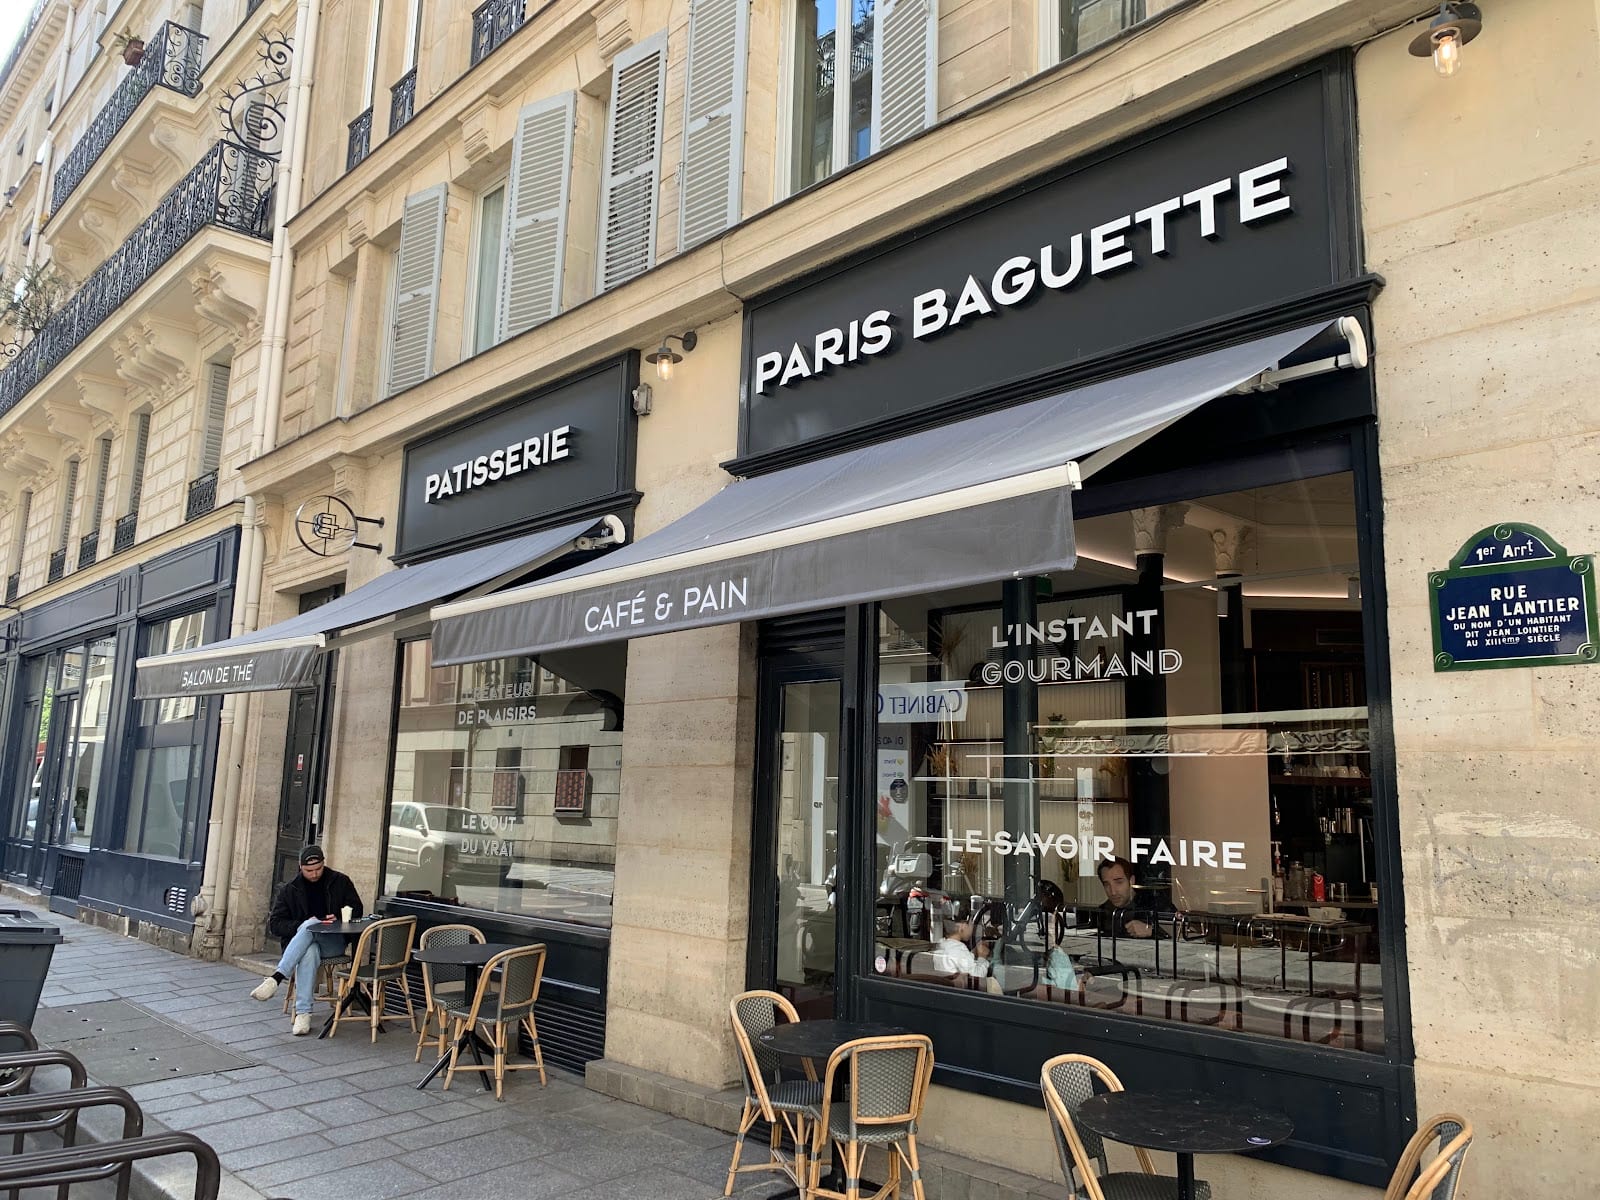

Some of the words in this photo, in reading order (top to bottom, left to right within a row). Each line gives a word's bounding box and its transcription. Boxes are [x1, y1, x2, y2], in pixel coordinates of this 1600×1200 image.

[756, 309, 893, 395] PARIS
[913, 156, 1291, 340] BAGUETTE
[425, 425, 571, 504] PATISSERIE
[1476, 546, 1496, 561] 1er
[1491, 585, 1528, 601] RUE
[584, 590, 646, 632] CAFÉ
[655, 593, 673, 621] &
[684, 577, 748, 616] PAIN
[1446, 605, 1490, 621] JEAN
[1503, 597, 1580, 617] LANTIER
[992, 609, 1158, 648] L'INSTANT
[1454, 623, 1466, 631] DU
[1471, 621, 1491, 629] NOM
[1497, 618, 1522, 627] D'UN
[1527, 615, 1572, 625] HABITANT
[1486, 628, 1511, 637] JEAN
[1517, 625, 1560, 635] LOINTIER
[1527, 634, 1561, 643] SIÈCLE
[182, 668, 214, 687] SALON
[215, 666, 230, 683] DE
[233, 659, 254, 682] THÉ
[981, 649, 1183, 686] GOURMAND
[458, 710, 474, 725] DE
[478, 705, 536, 723] PLAISIRS
[461, 813, 478, 829] LE
[480, 814, 517, 832] GOUT
[461, 838, 478, 854] DU
[482, 840, 513, 857] VRAI
[949, 829, 982, 853] LE
[994, 830, 1115, 862] SAVOIR
[1130, 837, 1247, 870] FAIRE
